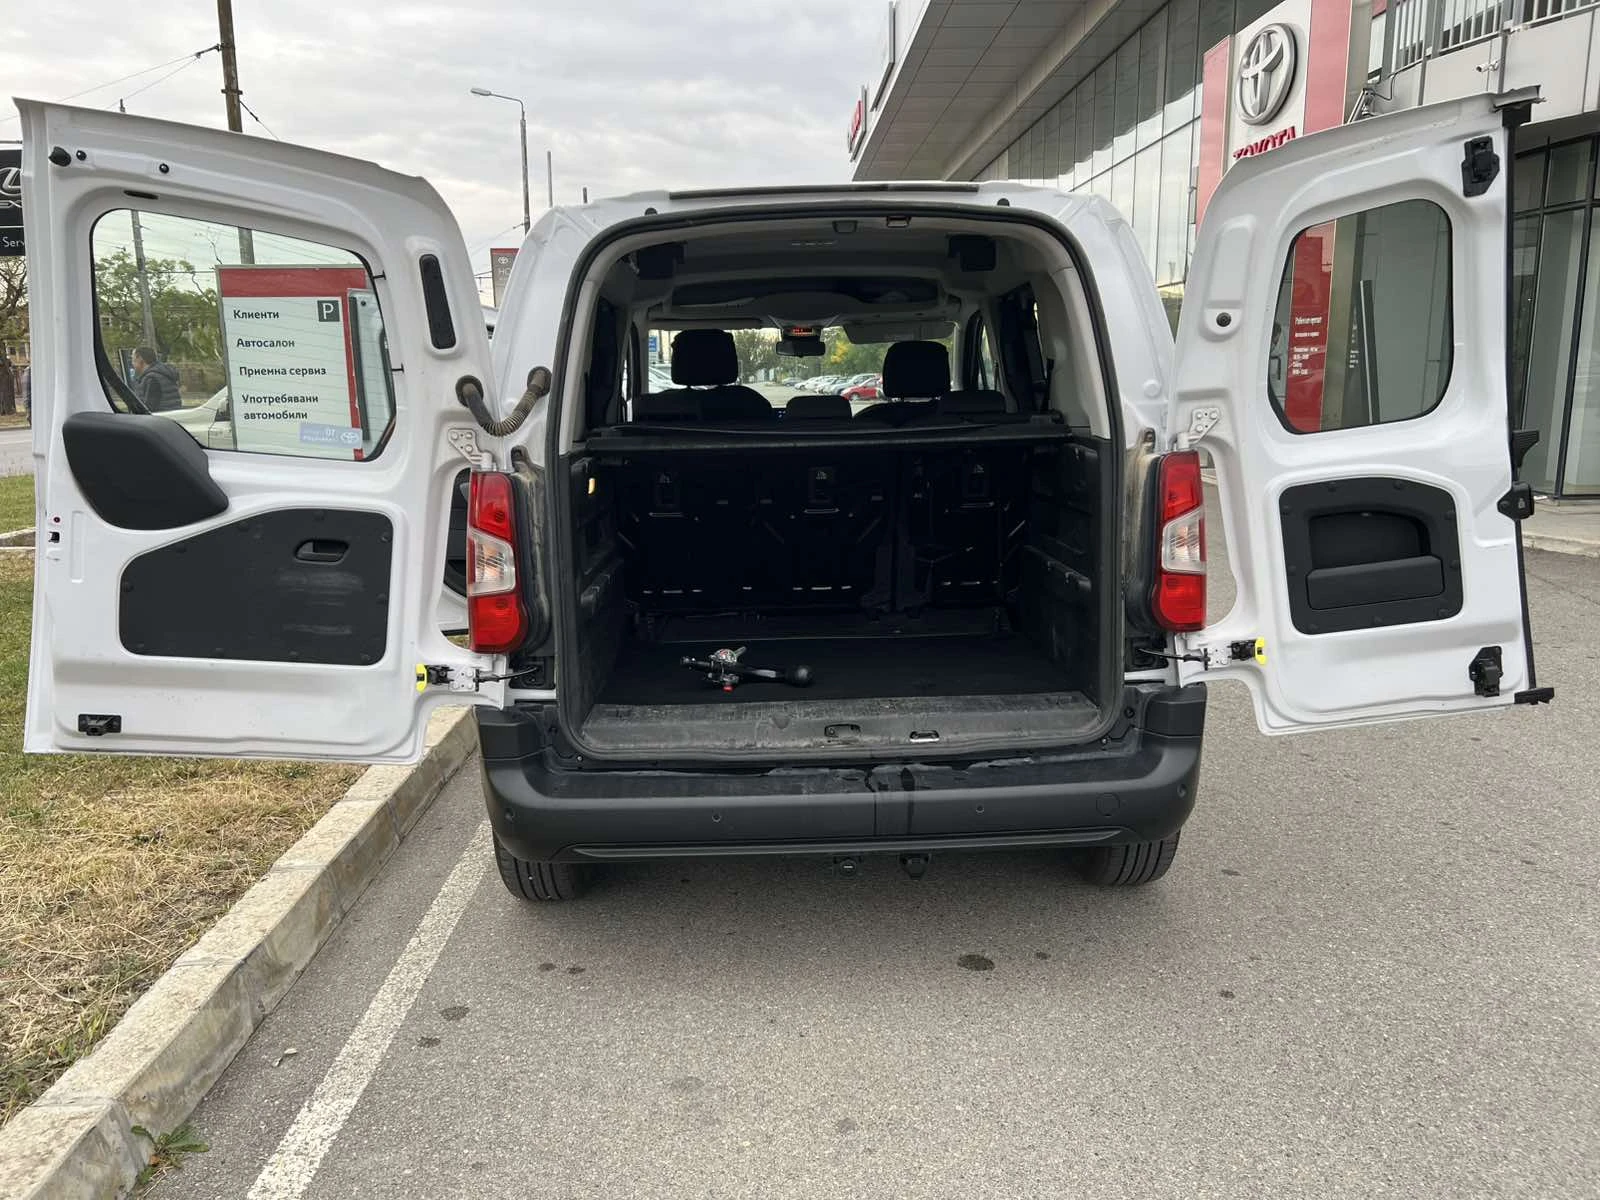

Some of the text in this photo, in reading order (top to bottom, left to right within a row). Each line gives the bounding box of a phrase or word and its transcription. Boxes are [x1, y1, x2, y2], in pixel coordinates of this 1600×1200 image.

[233, 309, 280, 319] Клиенти
[236, 338, 295, 348] Автосалон
[239, 366, 327, 377] Приемна сервиз
[241, 393, 319, 405] Употребявани
[244, 410, 308, 420] автомобили
